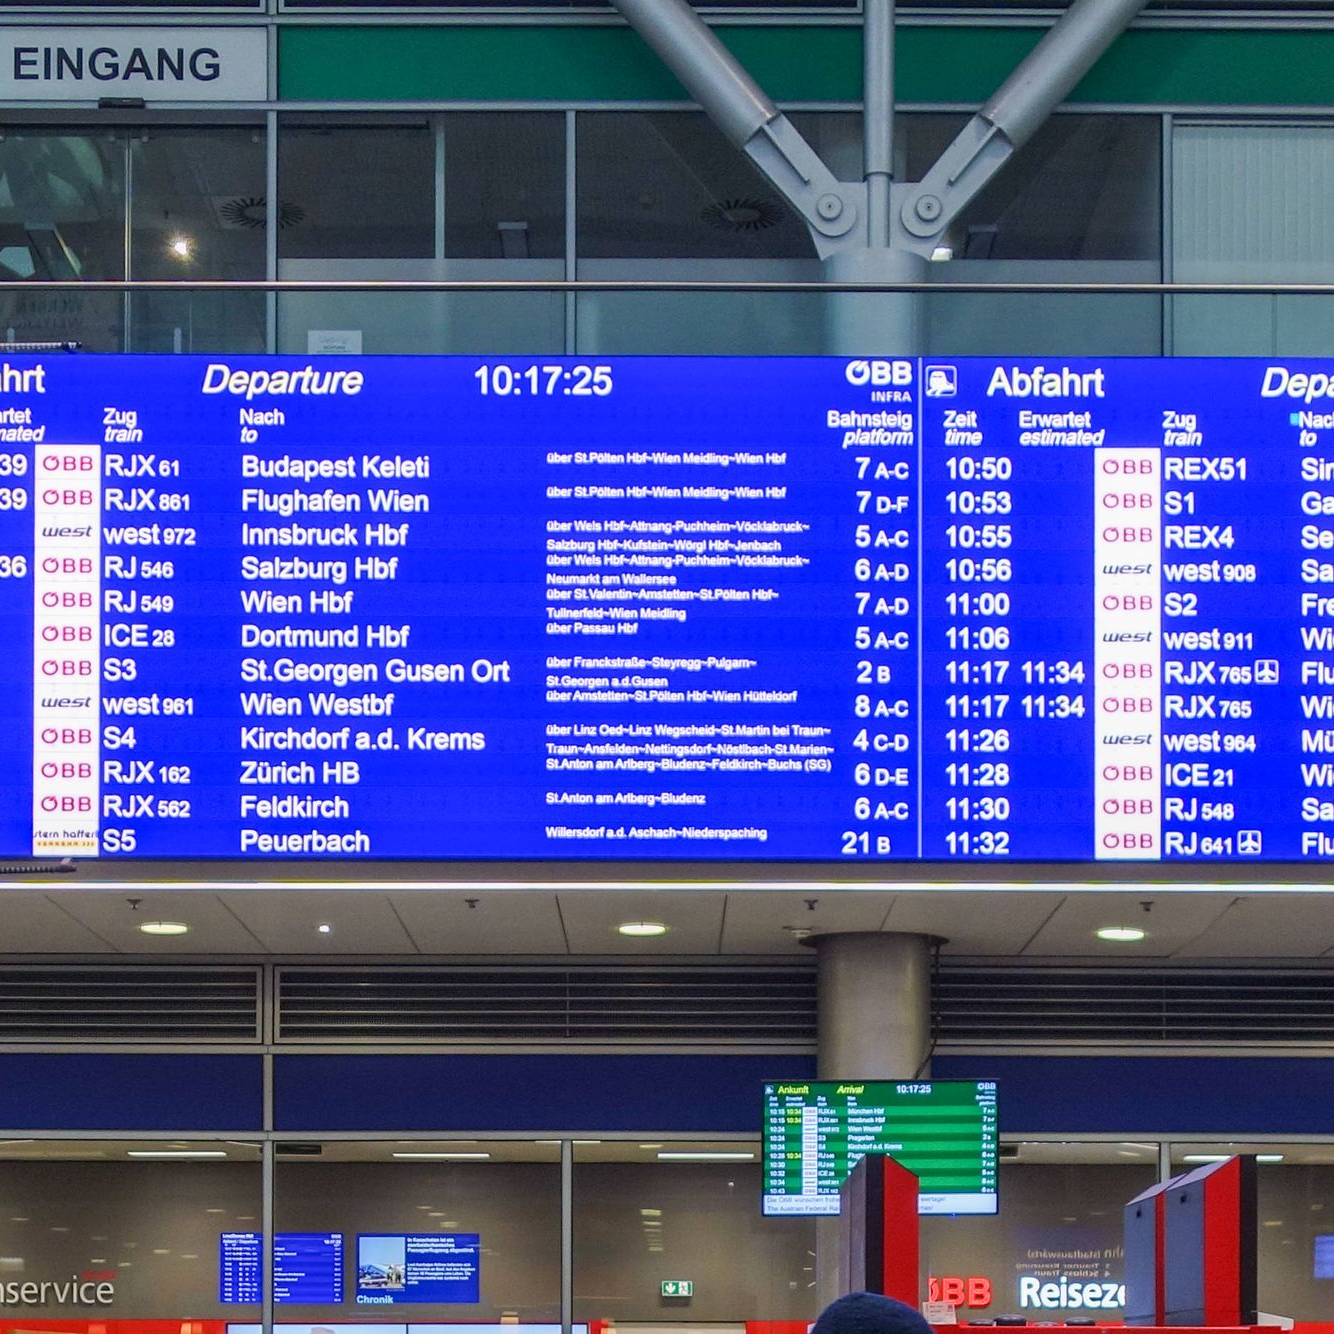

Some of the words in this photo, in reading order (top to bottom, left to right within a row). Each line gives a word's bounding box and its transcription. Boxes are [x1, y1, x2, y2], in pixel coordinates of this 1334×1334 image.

[14, 48, 219, 81] EINGANG
[203, 365, 363, 400] Departure
[475, 366, 612, 395] 10:17:25
[846, 361, 912, 385] ÖBB
[987, 366, 1104, 397] Abfahrt
[872, 391, 911, 402] INFRA
[103, 408, 137, 427] Zug
[240, 409, 284, 425] Nach
[828, 410, 912, 429] Bahnsteig
[943, 410, 977, 427] Zeit
[1019, 411, 1091, 428] Erwartet
[1162, 411, 1196, 431] Zug
[105, 425, 143, 442] train
[241, 427, 258, 443] to
[843, 427, 913, 449] platform
[945, 429, 982, 445] time
[1020, 429, 1105, 446] estimated
[1164, 429, 1202, 446] train
[1300, 430, 1317, 446] to
[43, 456, 93, 471] ÖBB
[105, 455, 155, 477] RJX
[159, 460, 179, 476] 61
[243, 455, 356, 482] Budapest
[363, 456, 429, 478] Keleti
[856, 457, 870, 479] 7
[875, 462, 908, 479] A-C
[947, 457, 1011, 480] 10:50
[1103, 460, 1152, 474] ÖBB
[1165, 458, 1246, 480] REX51
[43, 526, 92, 537] west
[103, 524, 160, 544] west
[164, 528, 195, 545] 972
[243, 523, 358, 545] Innsbruck
[366, 524, 409, 545] Hbf
[856, 525, 871, 547] 5
[875, 530, 908, 547] A-C
[42, 660, 91, 676] ÖBB
[104, 658, 136, 681] S3
[241, 658, 377, 686] St.Georgen
[386, 659, 464, 682] Gusen
[472, 659, 510, 682] Ort
[857, 661, 872, 683] 2
[878, 666, 890, 683] B
[41, 729, 91, 744] ÖBB
[104, 726, 136, 749] S4
[242, 727, 350, 749] Kirchdorf
[355, 728, 399, 749] a.d.
[408, 728, 485, 750] Krems
[853, 730, 869, 751] 4
[874, 734, 909, 751] C-D
[946, 729, 1009, 751] 11:26
[1103, 734, 1152, 744] west
[1164, 731, 1220, 752] west
[1224, 735, 1256, 752] 964
[946, 832, 1009, 854] 11:32
[1103, 833, 1152, 848] ÖBB
[1166, 832, 1197, 854] RJ
[1201, 837, 1231, 854] 641
[778, 1084, 809, 1094] Ankunft
[836, 1084, 864, 1094] Arrival
[356, 1294, 394, 1304] Chronik
